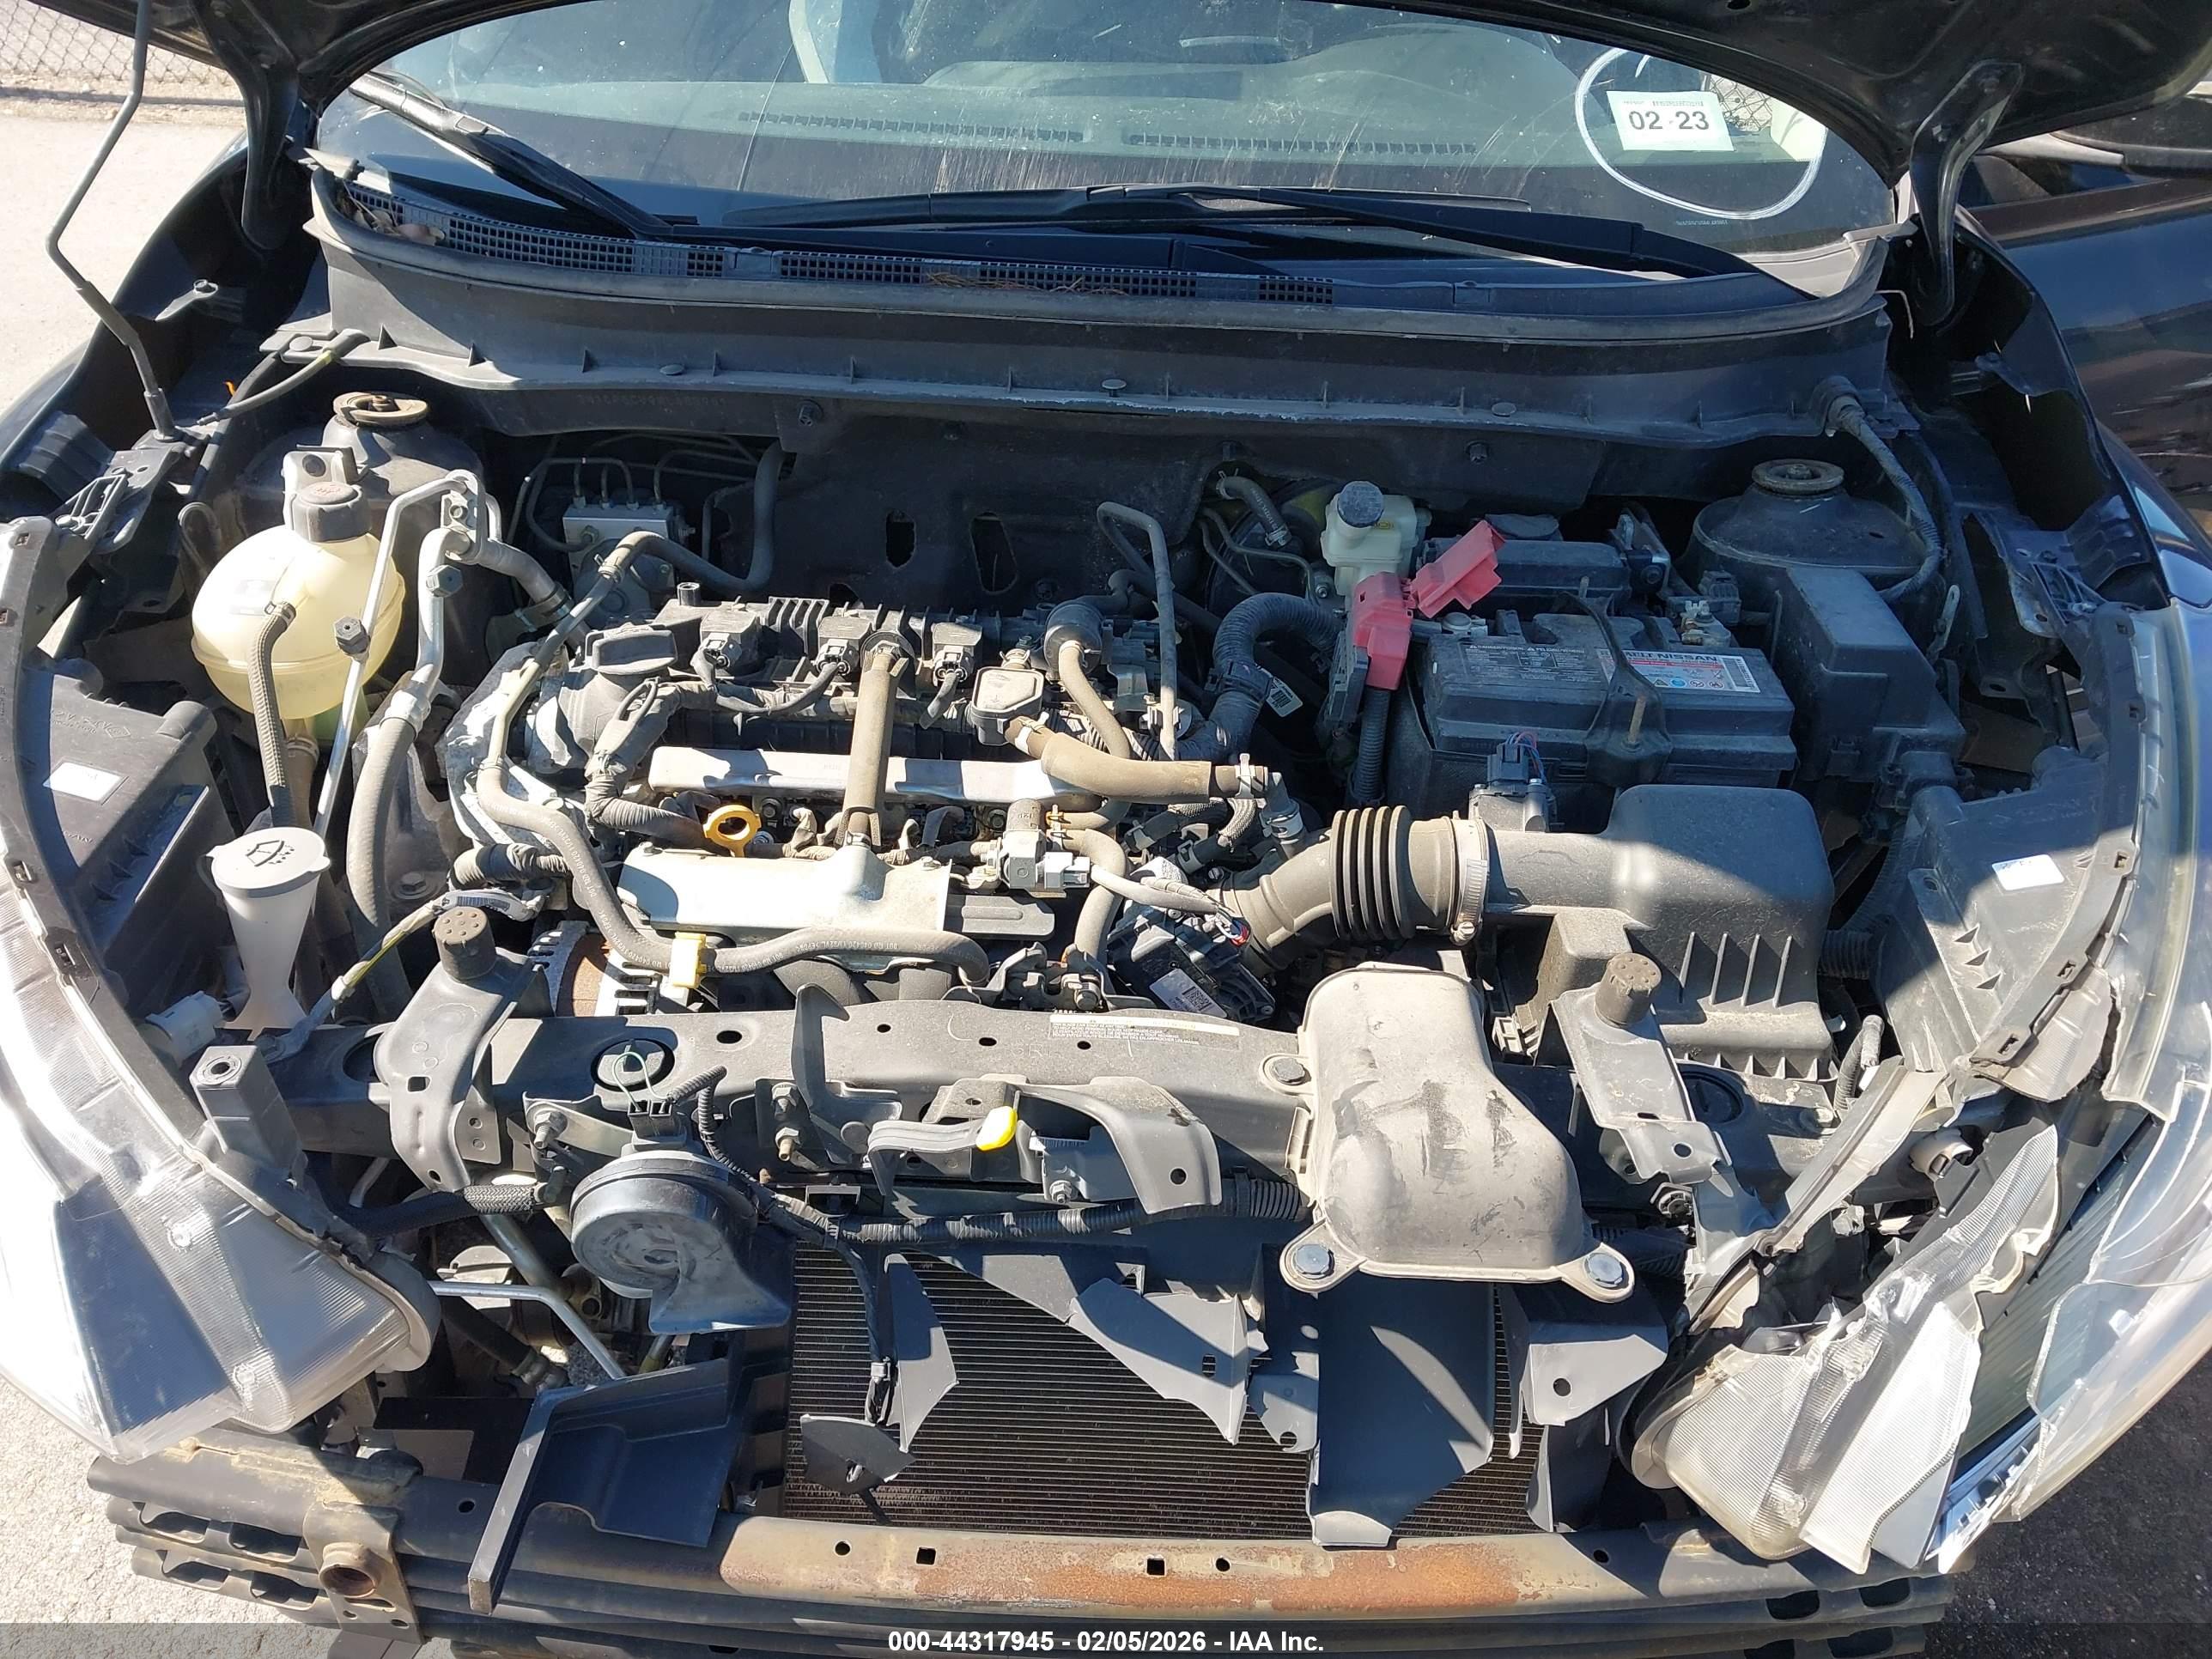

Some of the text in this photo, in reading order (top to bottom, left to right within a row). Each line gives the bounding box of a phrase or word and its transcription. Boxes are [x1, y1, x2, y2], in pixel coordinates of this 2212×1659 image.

[1628, 111, 1710, 131] 02 23
[1657, 653, 1718, 661] NISSAN
